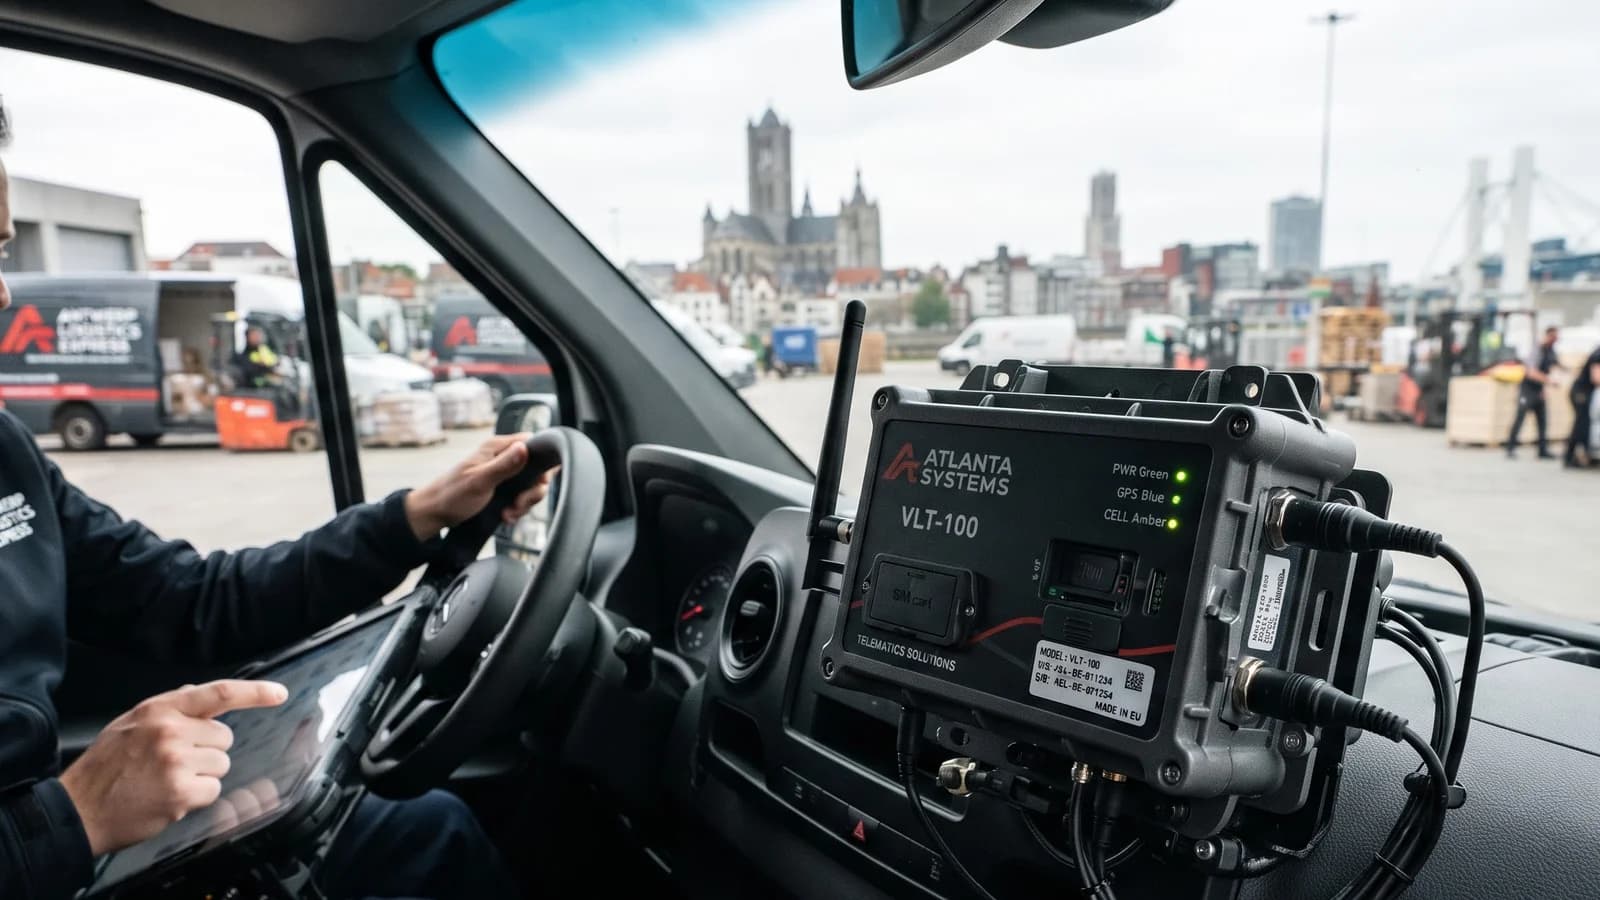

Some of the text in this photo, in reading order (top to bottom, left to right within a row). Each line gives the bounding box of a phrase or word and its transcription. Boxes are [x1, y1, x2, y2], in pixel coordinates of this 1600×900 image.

[923, 448, 1013, 476] ATLANTA
[1112, 463, 1169, 480] PWR Green
[920, 468, 1010, 496] SYSTEMS
[1117, 487, 1165, 503] GPS Blue
[902, 505, 979, 538] VLT-100
[1104, 508, 1167, 527] CELL Amber
[857, 634, 957, 672] TELEMATICS SOLUTIONS
[1069, 654, 1101, 670] VLT-100
[1094, 701, 1142, 721] MADE IN EU
